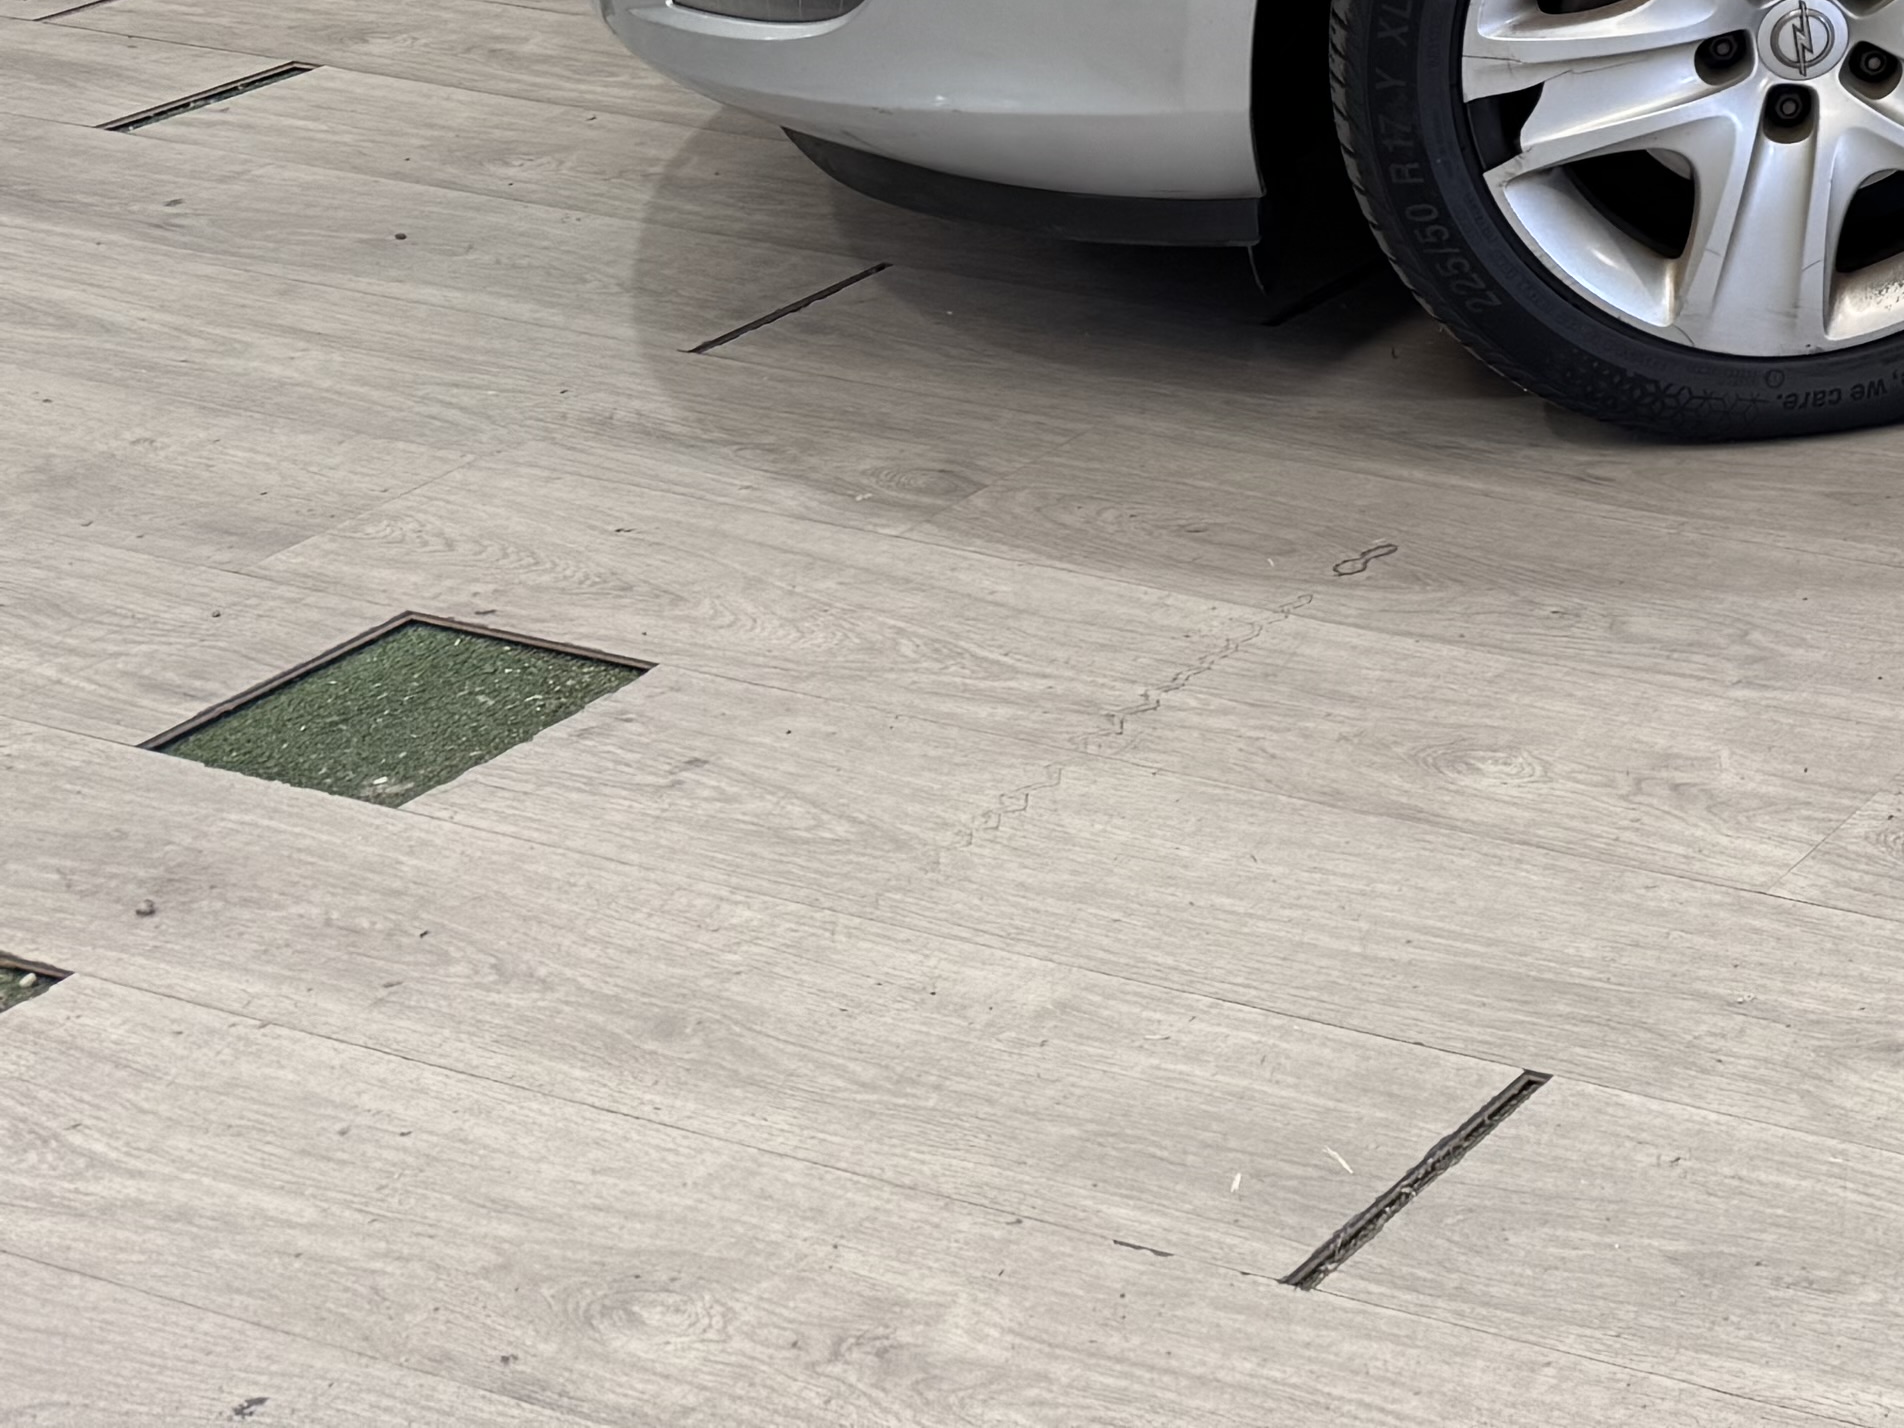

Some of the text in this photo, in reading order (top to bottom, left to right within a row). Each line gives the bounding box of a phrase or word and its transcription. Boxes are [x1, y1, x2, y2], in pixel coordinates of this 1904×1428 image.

[1374, 66, 1408, 92] Y
[1404, 201, 1504, 314] 225/50
[1775, 389, 1842, 411] care.
[1849, 380, 1888, 402] we
